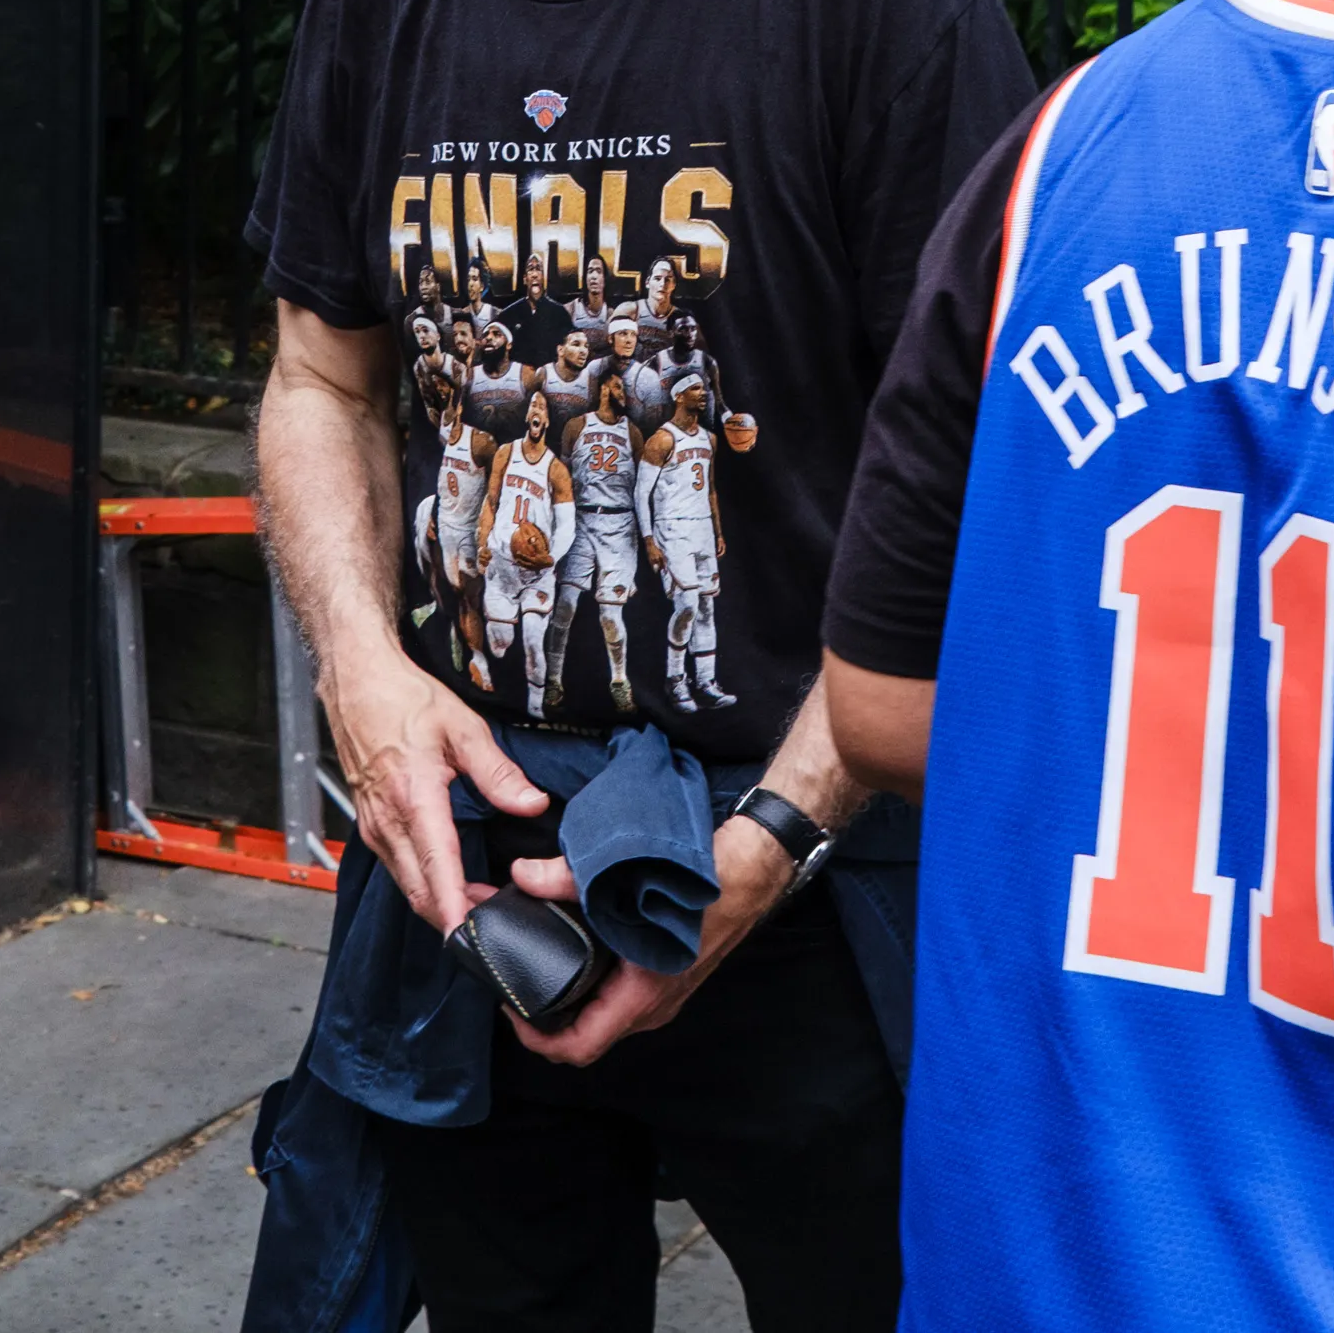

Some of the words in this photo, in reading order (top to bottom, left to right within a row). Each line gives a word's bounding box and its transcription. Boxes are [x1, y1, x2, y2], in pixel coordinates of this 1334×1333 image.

[431, 141, 480, 163] NEW
[488, 140, 557, 163] YORK
[567, 134, 672, 162] KNICKS
[389, 166, 734, 300] FINALS
[589, 444, 620, 473] 32
[446, 471, 459, 498] 8
[691, 463, 705, 492] 3
[513, 495, 530, 524] 11
